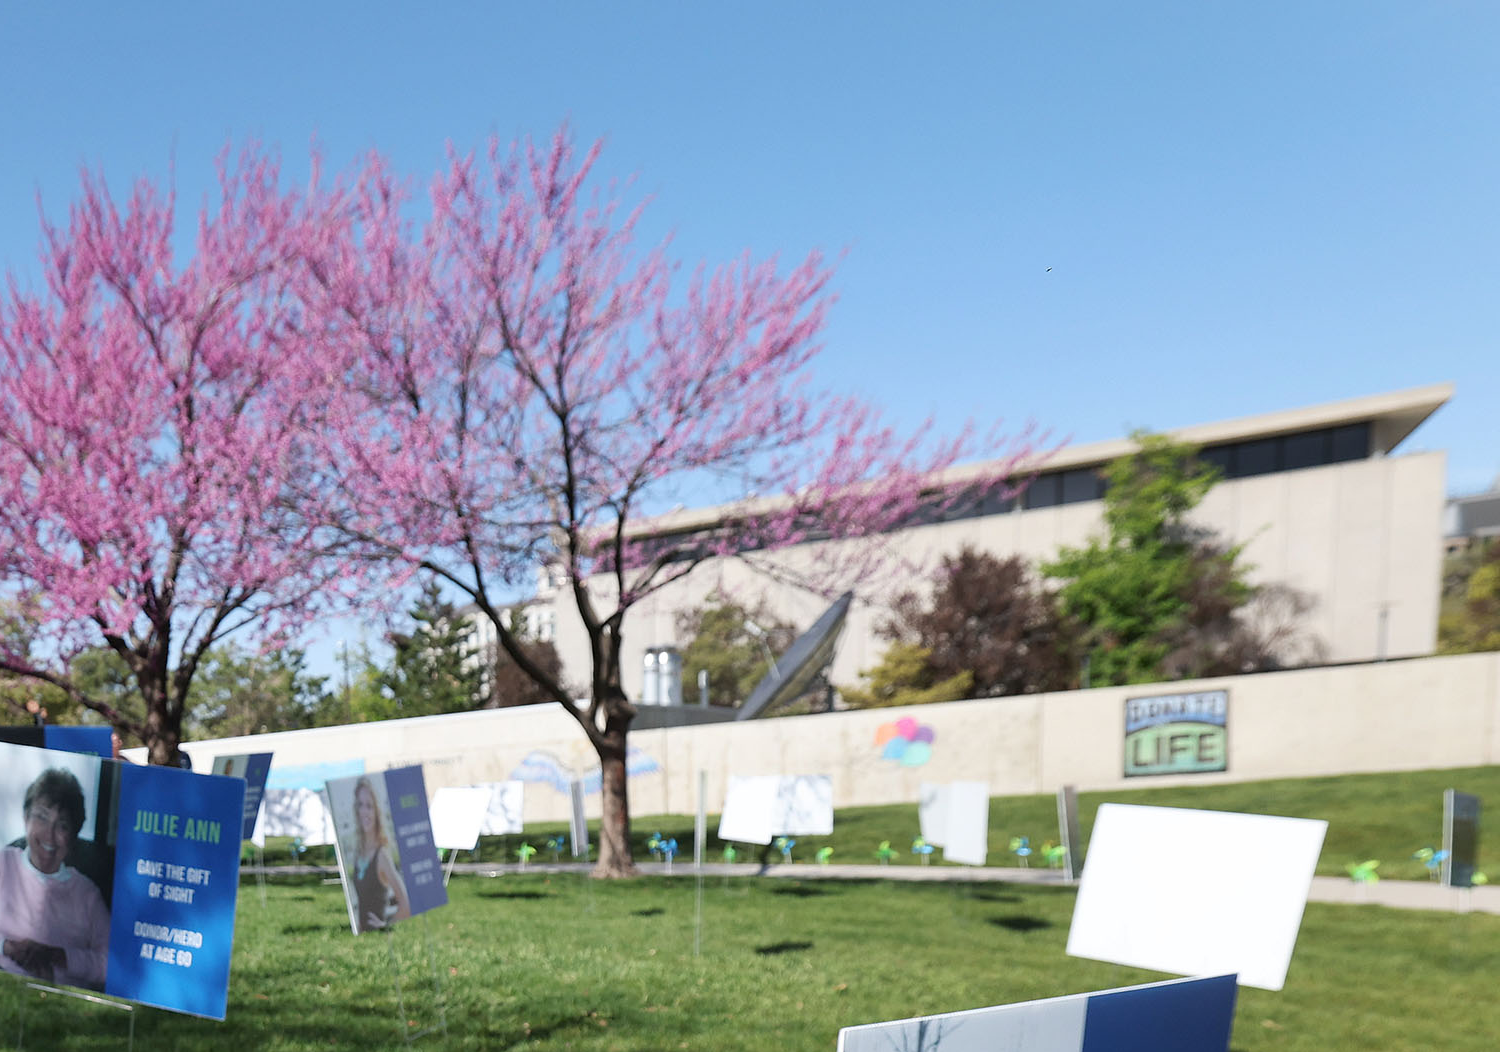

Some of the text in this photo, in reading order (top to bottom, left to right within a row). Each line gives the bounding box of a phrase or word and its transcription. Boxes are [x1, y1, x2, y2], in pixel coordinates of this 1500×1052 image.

[1132, 733, 1218, 767] LIFE
[134, 810, 221, 844] JULIE ANN
[137, 859, 211, 886] GAVE THE GIFT
[148, 882, 195, 904] OF SIGHT
[134, 921, 203, 948] DONOR/HERO
[140, 943, 155, 960] AT
[154, 946, 176, 965] AGE
